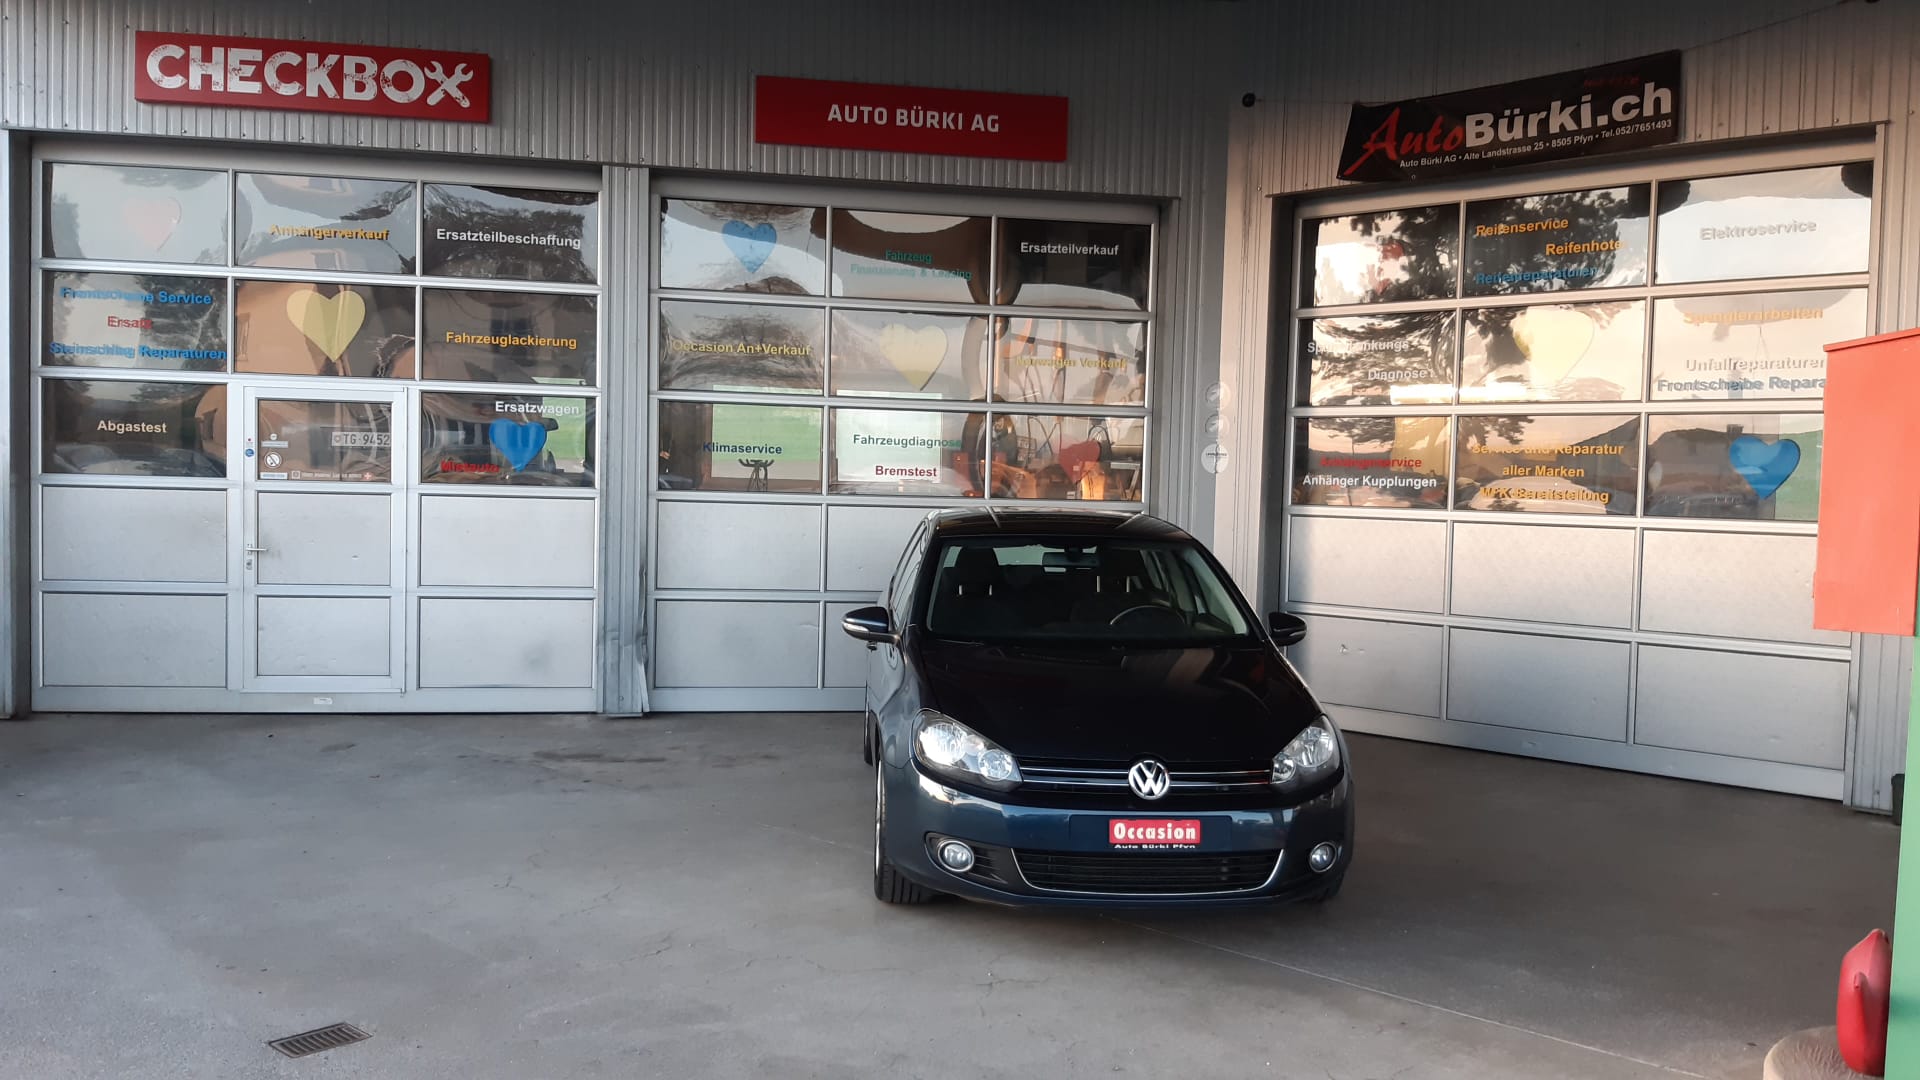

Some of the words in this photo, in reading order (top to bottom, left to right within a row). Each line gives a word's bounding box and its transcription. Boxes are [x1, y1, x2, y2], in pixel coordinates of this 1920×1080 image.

[146, 44, 474, 107] CHECKBOX
[827, 104, 888, 125] AUTO
[895, 105, 963, 131] BÜRKI
[970, 114, 999, 133] AG
[1400, 160, 1419, 168] Auto
[1421, 157, 1442, 166] Bürki
[1444, 154, 1457, 163] AG
[1463, 152, 1480, 161] Alte
[1482, 144, 1531, 158] Landstrasse
[1534, 141, 1544, 150] 25
[1551, 137, 1572, 147] 8505
[1574, 134, 1593, 145] Pfyn
[1475, 218, 1569, 237] Reifenservice
[1699, 219, 1817, 241] Elektroservice
[436, 228, 581, 249] Ersatzteilbeschaffung
[885, 250, 932, 264] Fahrzeug
[1020, 242, 1119, 257] Ersatzteilverkauf
[932, 268, 972, 281] Leasing
[159, 290, 213, 305] Service
[446, 331, 577, 350] Fahrzeuglackierung
[671, 340, 733, 353] Occasion
[139, 345, 227, 360] Reparaturen
[1368, 367, 1428, 383] Diagnose
[1657, 376, 1763, 393] Frontscheibe
[495, 400, 579, 418] Ersatzwagen
[97, 419, 167, 434] Abgastest
[703, 442, 782, 455] Klimaservice
[853, 433, 962, 449] Fahrzeugdiagnose
[1525, 444, 1551, 455] und
[1554, 444, 1625, 456] Reparatur
[875, 465, 938, 478] Bremstest
[1502, 464, 1532, 476] aller
[1535, 465, 1585, 478] Marken
[1303, 474, 1359, 489] Anhänger
[1362, 475, 1437, 489] Kupplungen
[1113, 822, 1196, 840] Occasion
